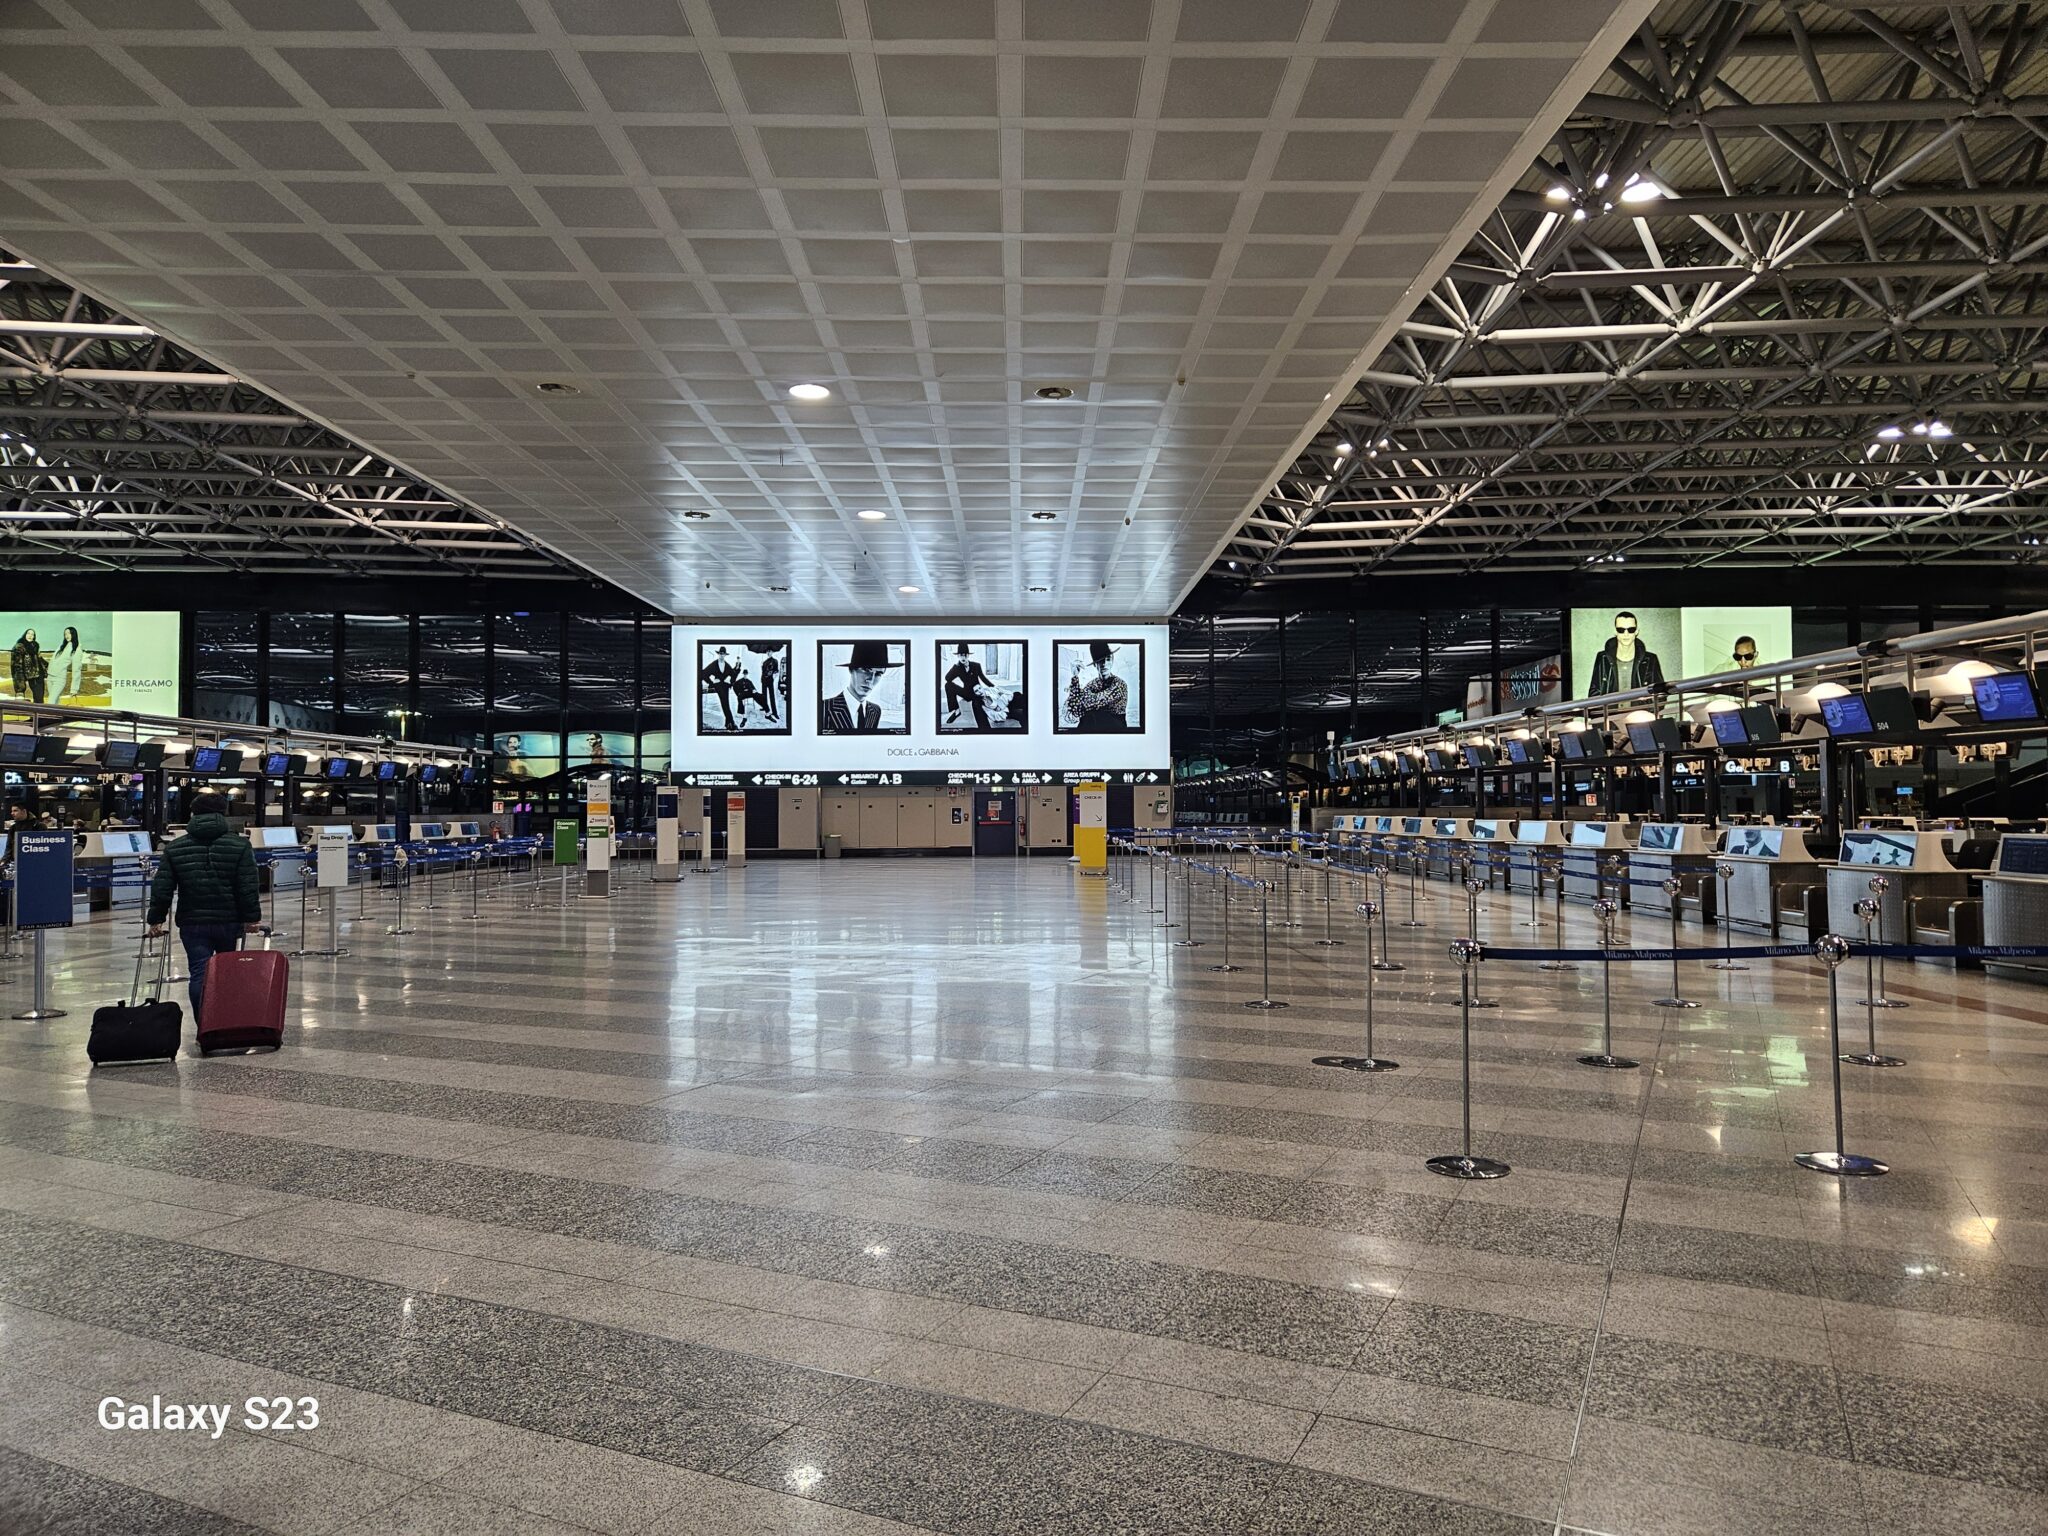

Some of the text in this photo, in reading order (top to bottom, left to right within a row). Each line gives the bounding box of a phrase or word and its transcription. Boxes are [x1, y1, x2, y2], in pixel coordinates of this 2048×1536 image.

[1877, 722, 1889, 730] 504
[887, 748, 913, 756] DOLCE
[918, 748, 960, 756] GABBANA
[791, 774, 818, 785] 6-24
[974, 773, 990, 784] 1-5
[21, 836, 65, 844] Business
[21, 845, 50, 853] Class
[1603, 949, 1673, 960] Milano Malpensa
[1764, 946, 1792, 955] Milano
[1968, 946, 2036, 956] Milano Malpensa
